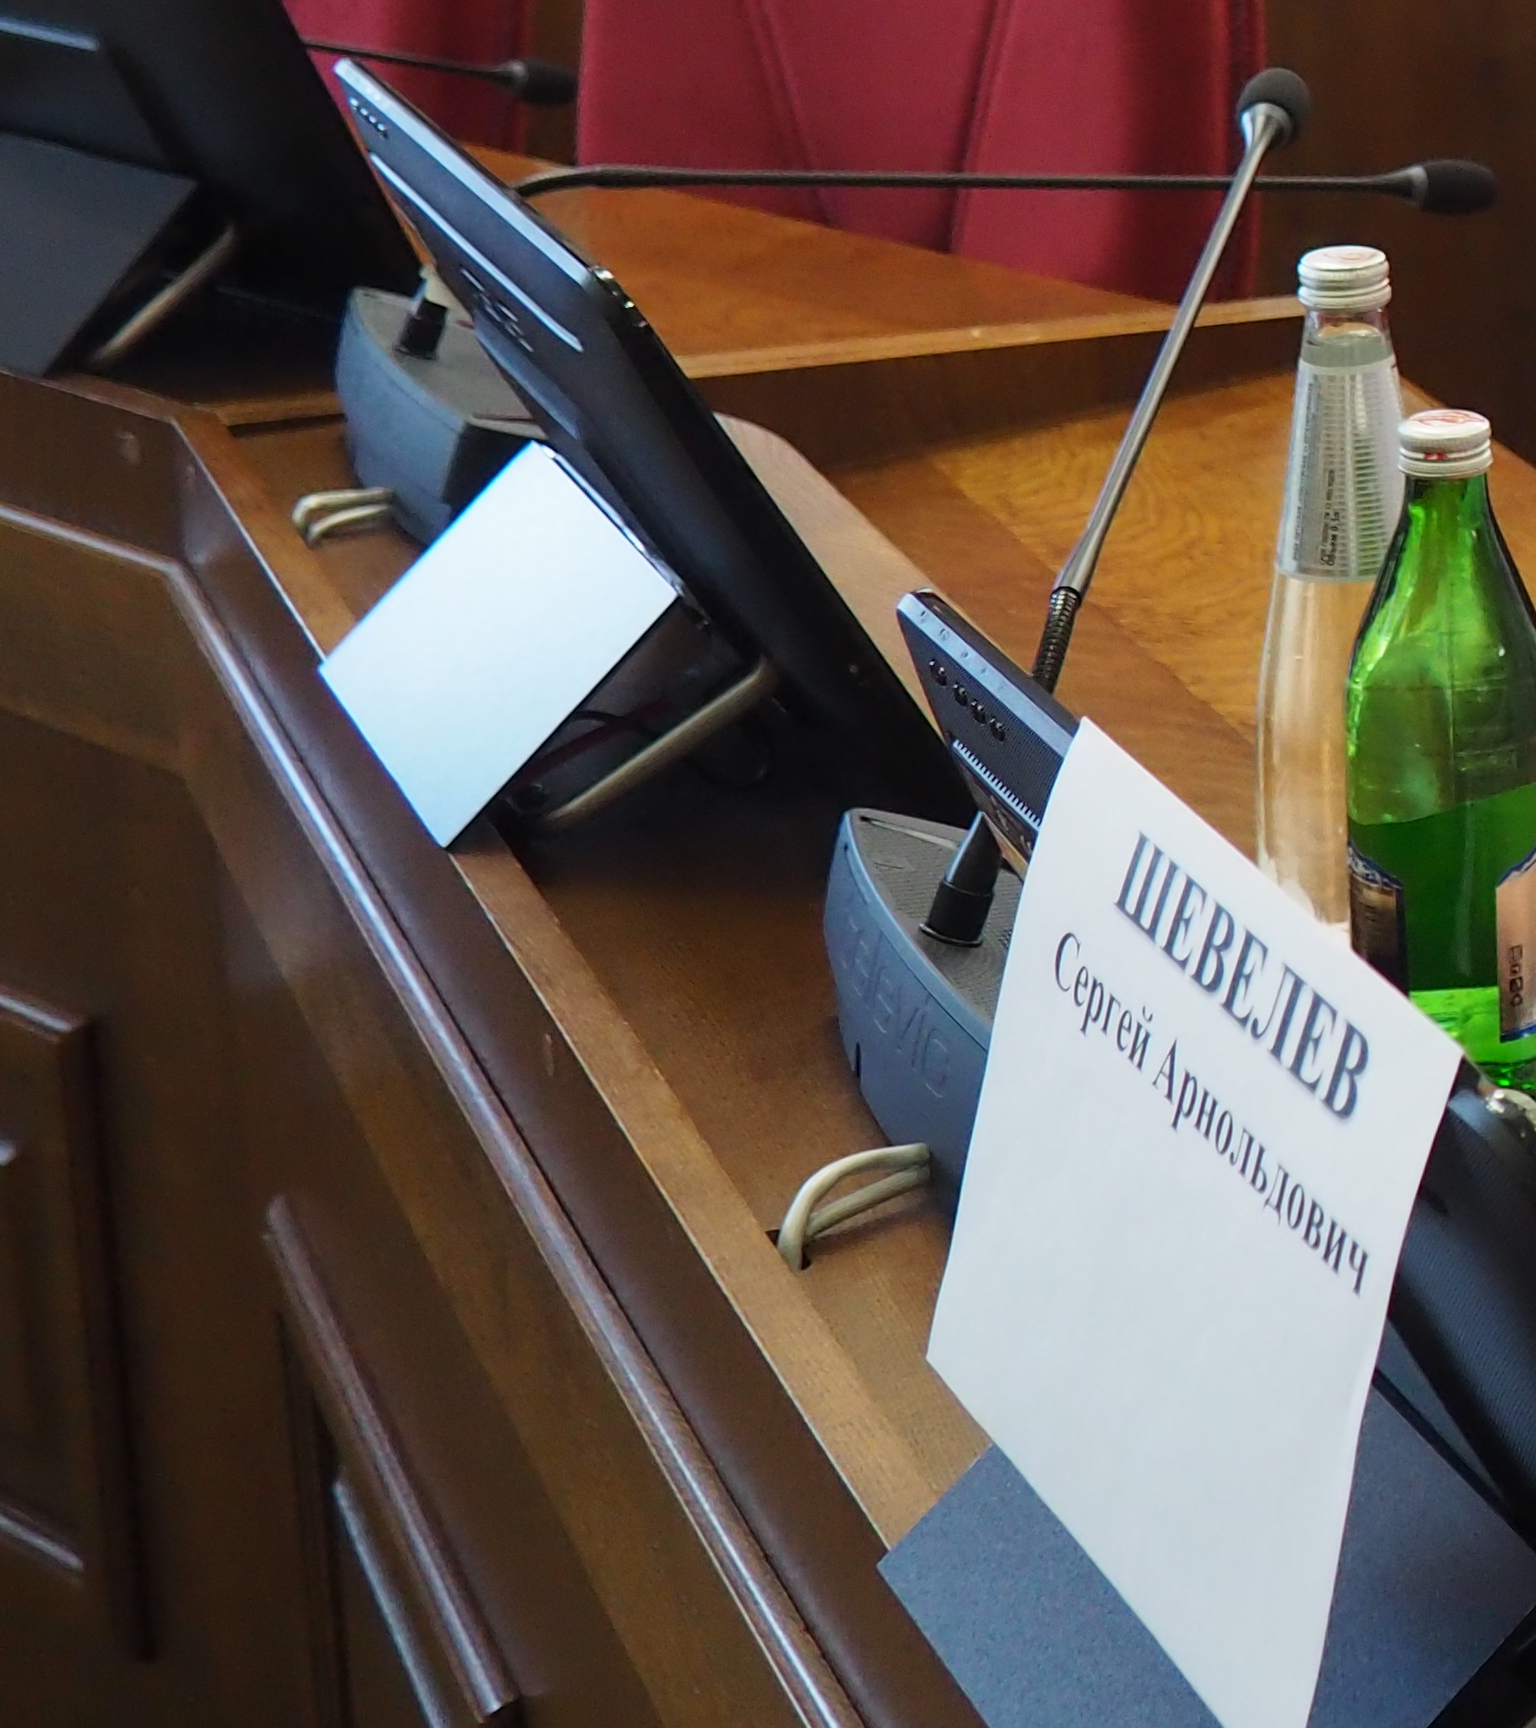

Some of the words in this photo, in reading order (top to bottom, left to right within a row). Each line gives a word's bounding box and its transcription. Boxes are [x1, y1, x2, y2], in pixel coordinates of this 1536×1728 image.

[1054, 931, 1154, 1072] Сергей
[1151, 1037, 1370, 1297] Арнольдович
[1114, 830, 1370, 1120] ШЕВЕЛЕВ
